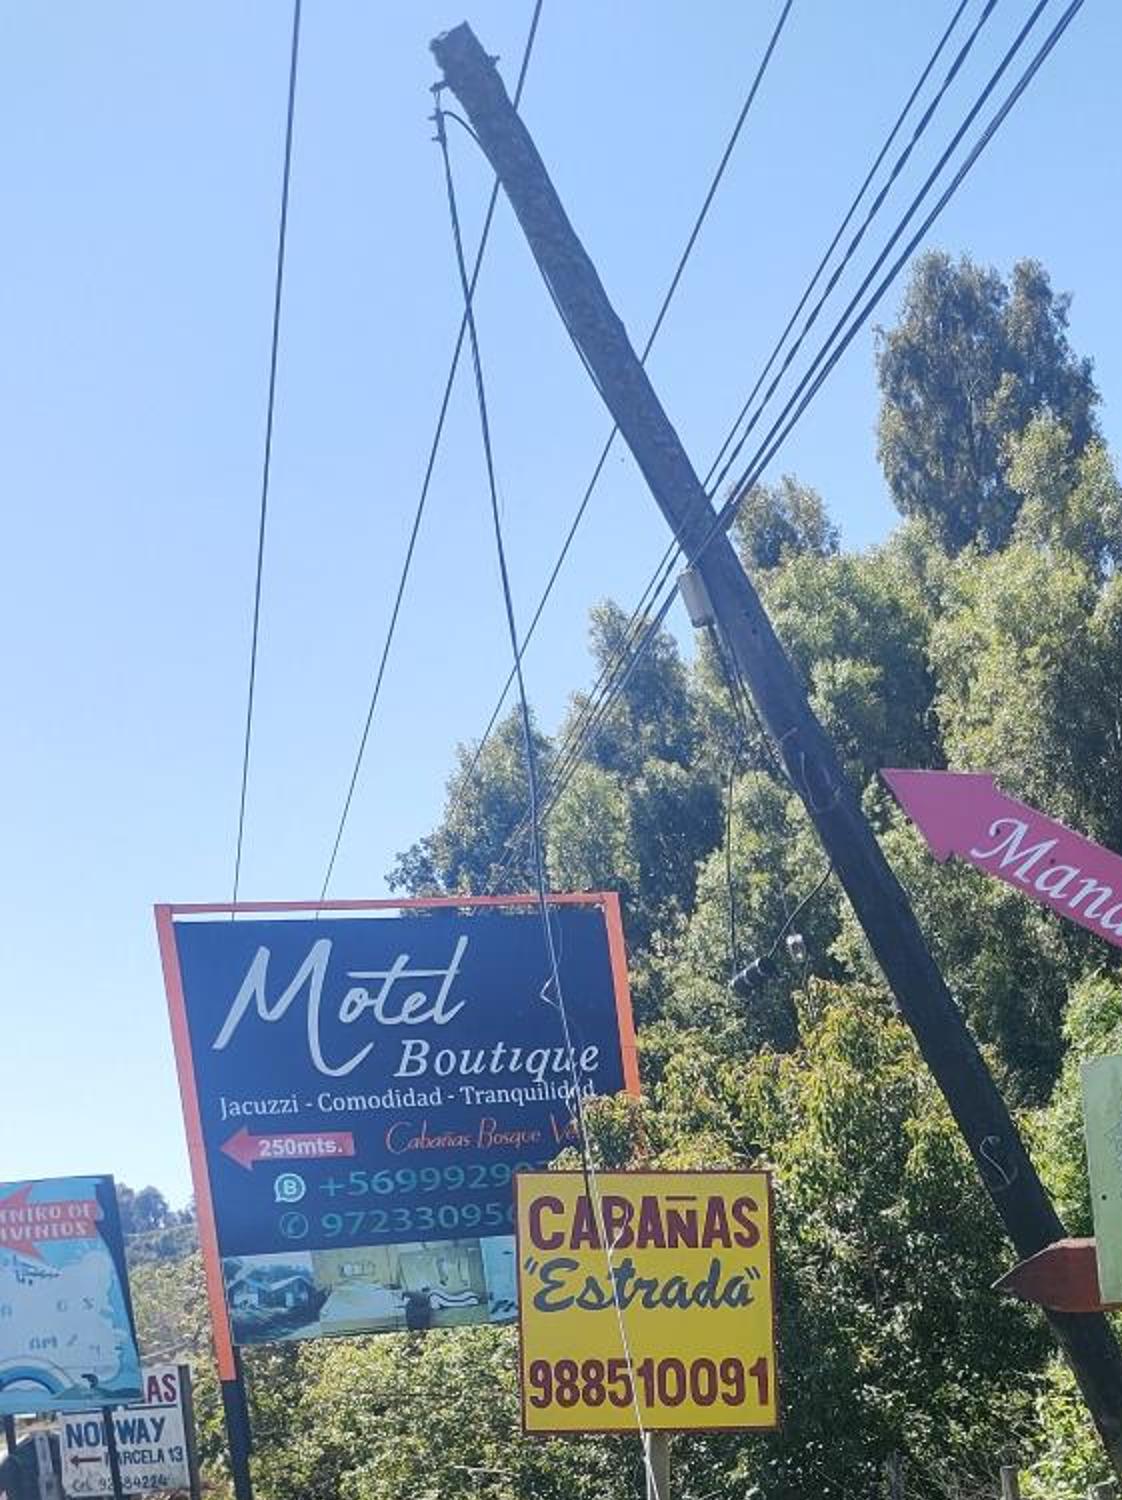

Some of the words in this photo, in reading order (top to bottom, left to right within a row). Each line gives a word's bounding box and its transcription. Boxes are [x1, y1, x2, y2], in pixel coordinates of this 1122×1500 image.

[212, 934, 469, 1077] Motel
[393, 1037, 600, 1083] Boutique
[220, 1094, 299, 1120] Jacuzzi
[318, 1086, 443, 1113] Comodidad
[258, 1138, 344, 1157] 250mts.
[385, 1119, 473, 1155] Cabañas
[477, 1117, 542, 1150] Bosque
[321, 1202, 517, 1238] 97233095
[528, 1195, 761, 1251] CABAÑAS
[529, 1356, 769, 1409] 988510091
[168, 1445, 184, 1463] 13
